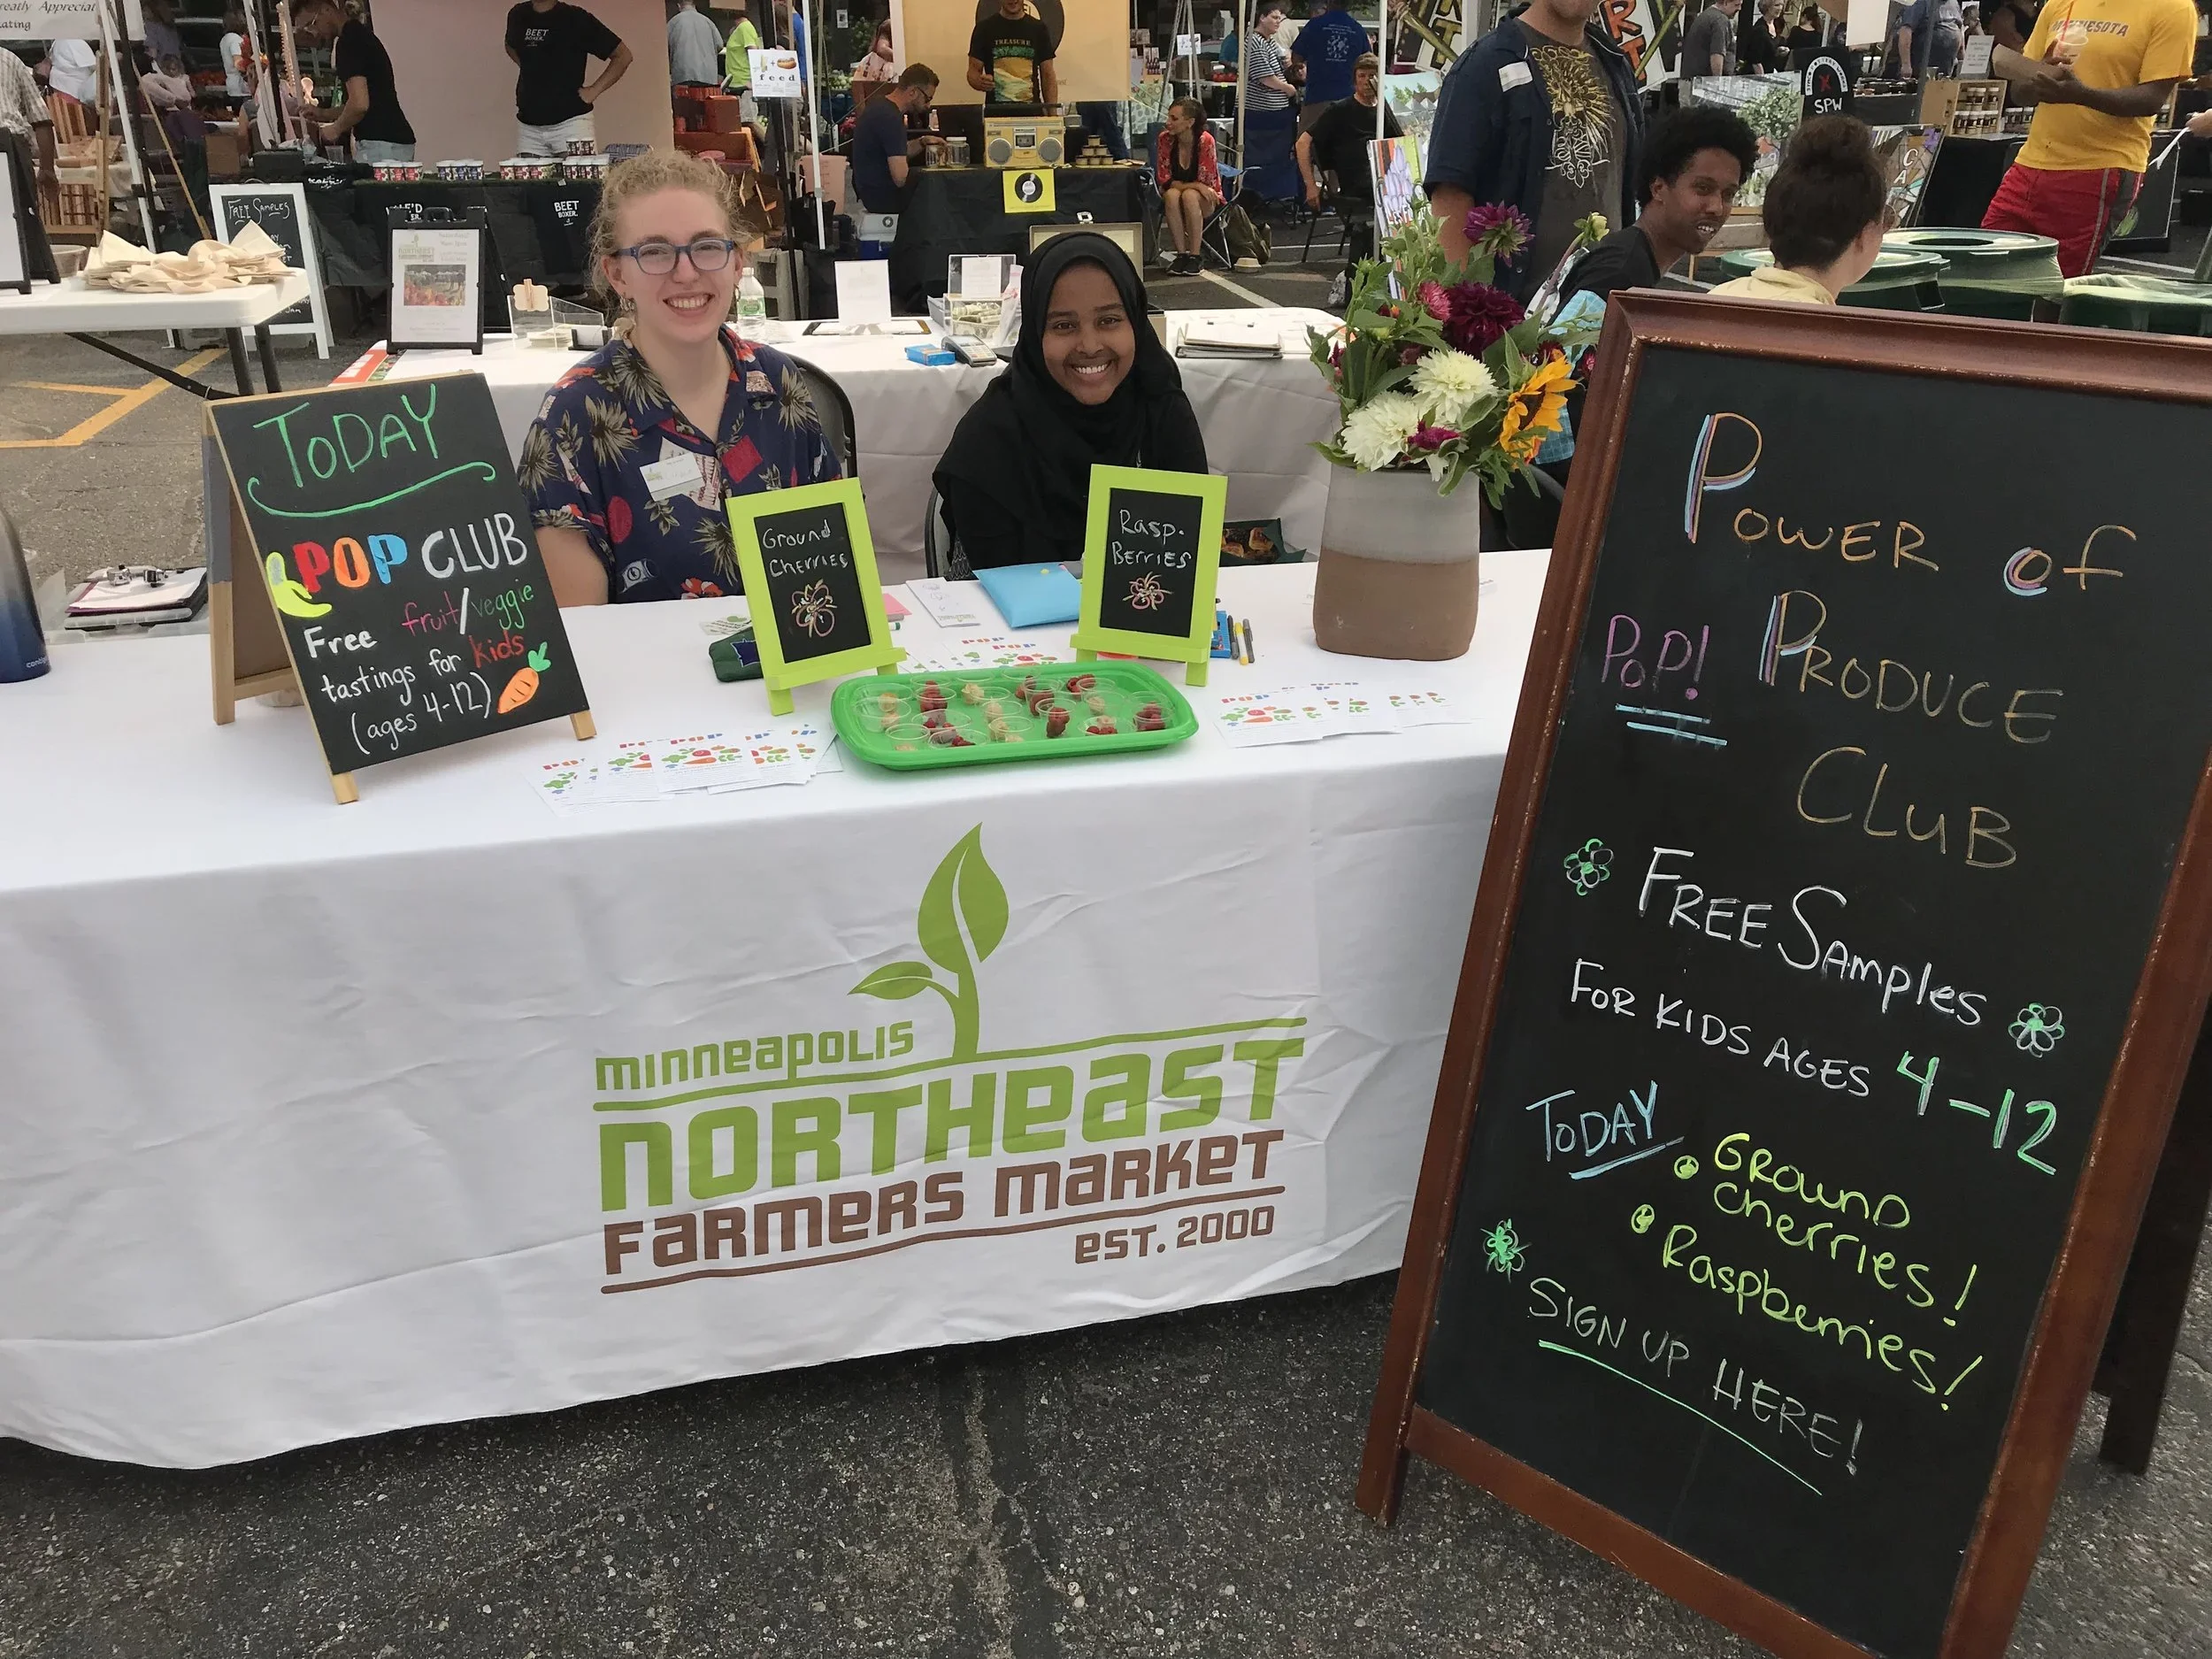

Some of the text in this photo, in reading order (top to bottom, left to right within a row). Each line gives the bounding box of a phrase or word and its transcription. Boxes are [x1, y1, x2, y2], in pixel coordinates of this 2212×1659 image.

[1814, 97, 1843, 114] SPW
[227, 197, 290, 225] FREE SAMPLES
[554, 200, 580, 212] BEET
[557, 210, 579, 219] BOXER.
[253, 384, 440, 488] TODAY
[763, 518, 832, 549] Ground
[1118, 509, 1186, 545] Rasp.
[1685, 411, 2137, 596] POWER of
[293, 512, 527, 593] POP CLUB
[303, 579, 534, 659] Free fruit/veggie
[1601, 614, 1710, 700] POP!
[321, 629, 525, 706] tastings for kids
[1759, 590, 2063, 744] PRODUCE
[351, 671, 492, 755] (ages 4-12)
[1797, 746, 2017, 868] CLUB
[1639, 846, 1772, 949] FREE
[1571, 957, 2057, 1175] FOR KIDS AGES 4-12
[1525, 1080, 1659, 1162] TODAY
[1176, 1204, 1275, 1249] 2000
[1527, 1277, 1864, 1477] SIGN UP HERE!
